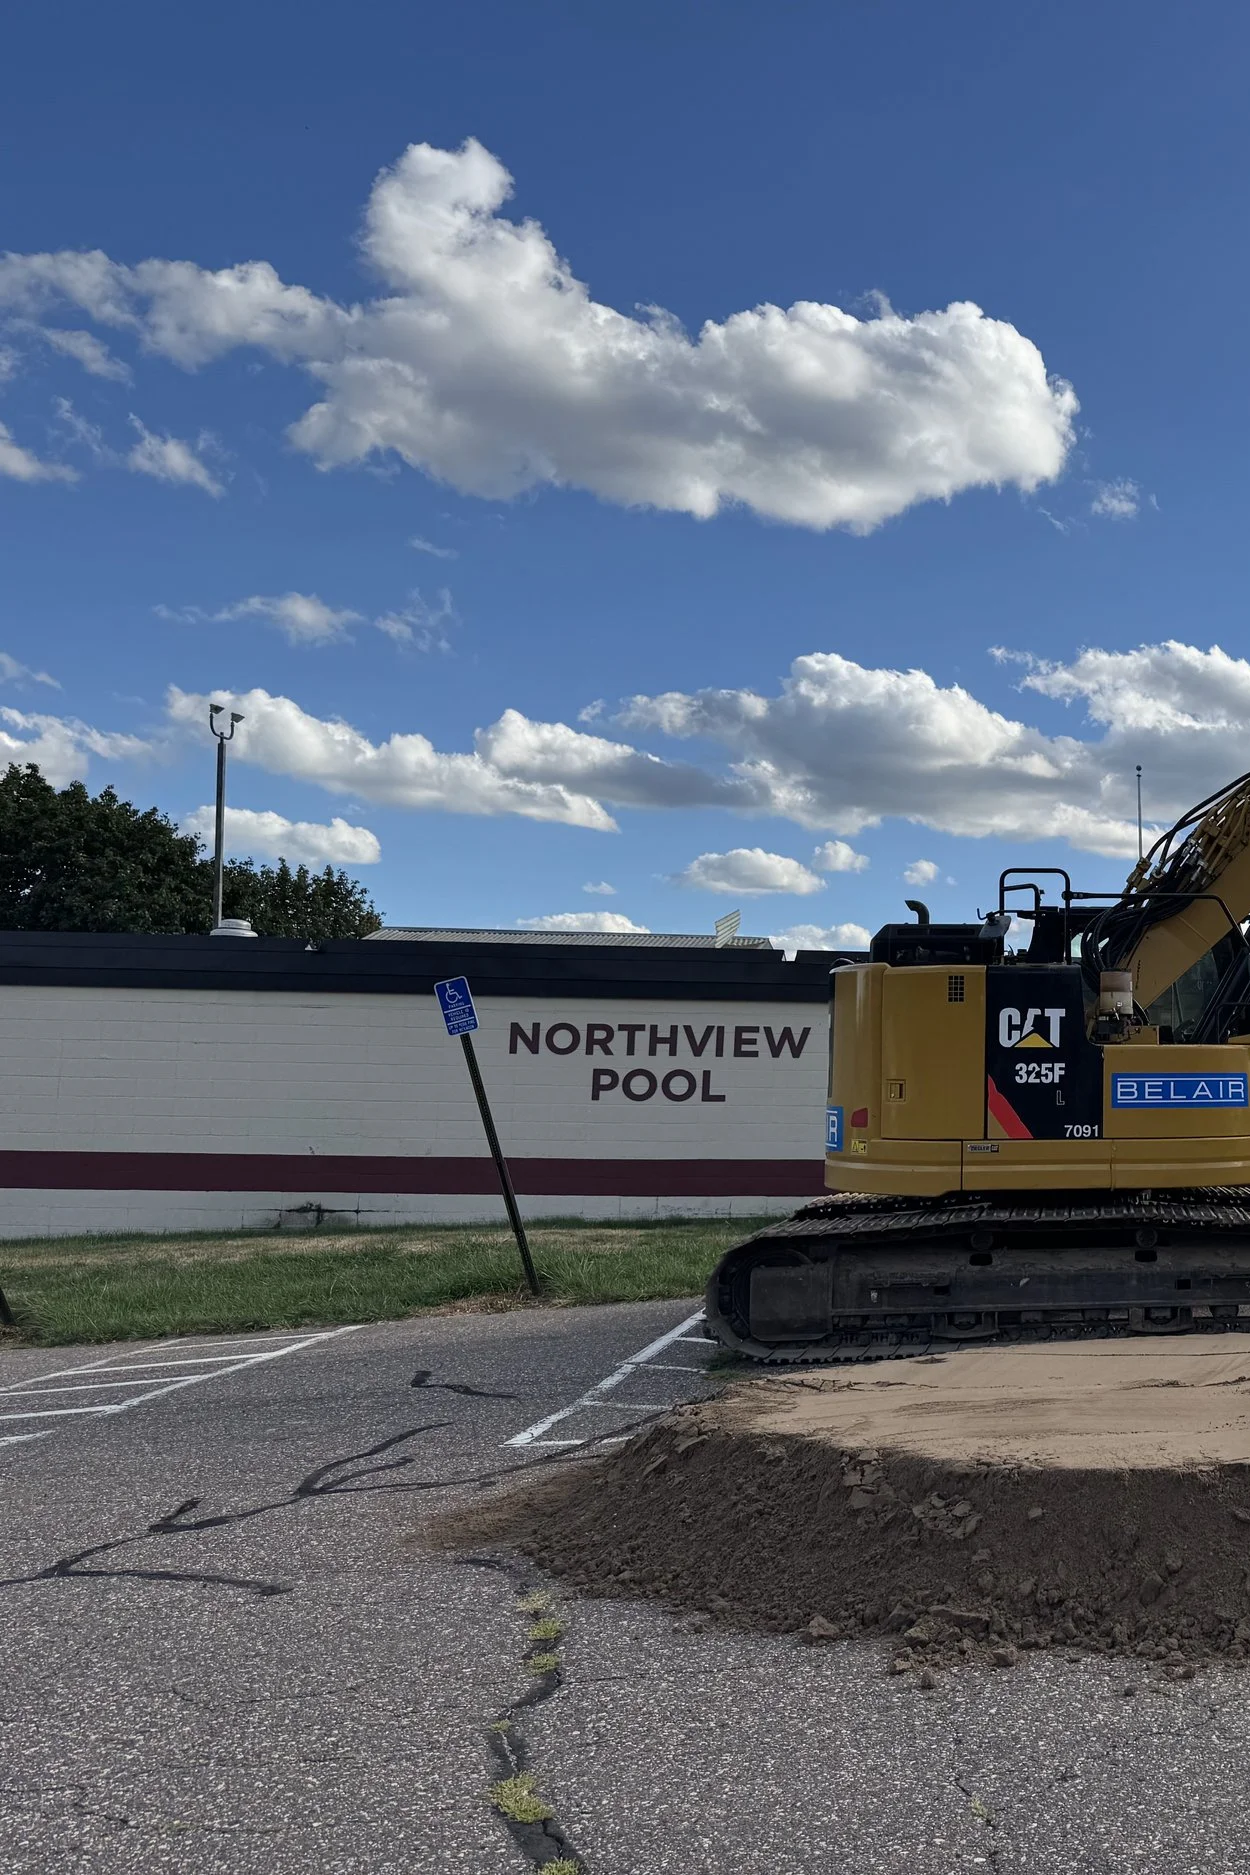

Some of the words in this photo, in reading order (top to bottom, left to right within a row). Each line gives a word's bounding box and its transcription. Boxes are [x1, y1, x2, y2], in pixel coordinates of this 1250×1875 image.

[999, 1008, 1066, 1048] CAT
[508, 1022, 812, 1059] NORTHVIEW
[1015, 1062, 1066, 1084] 325F
[591, 1068, 726, 1102] POOL
[1116, 1081, 1245, 1100] BELAIR
[1056, 1090, 1065, 1106] L
[1064, 1124, 1099, 1138] 7091
